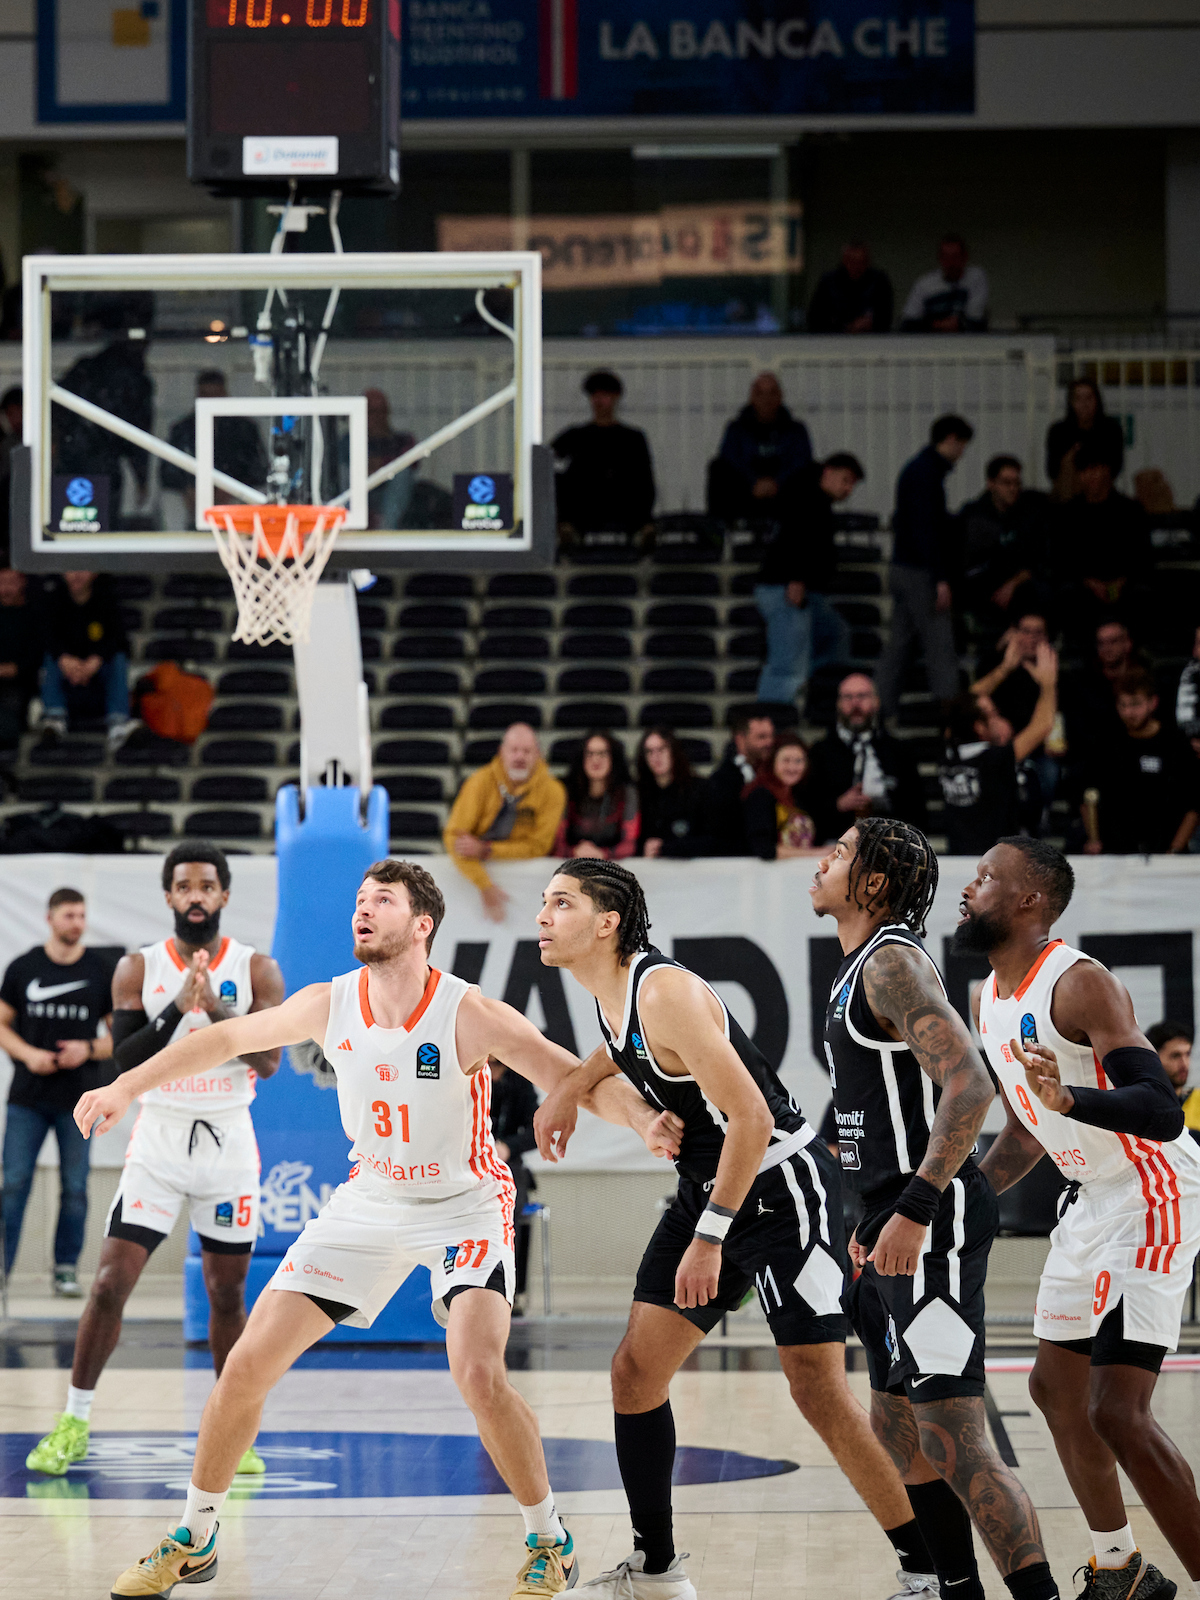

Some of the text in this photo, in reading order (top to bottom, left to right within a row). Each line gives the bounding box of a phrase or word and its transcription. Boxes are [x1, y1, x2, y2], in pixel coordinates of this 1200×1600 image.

[601, 17, 947, 60] LA BANCA CHE
[1015, 1084, 1039, 1126] 9
[371, 1100, 410, 1143] 31
[839, 1127, 865, 1139] energia
[236, 1195, 252, 1227] 5
[456, 1239, 489, 1268] 31
[313, 1267, 344, 1283] Staffbase
[1093, 1270, 1111, 1316] 9
[1050, 1312, 1082, 1321] Staffbase
